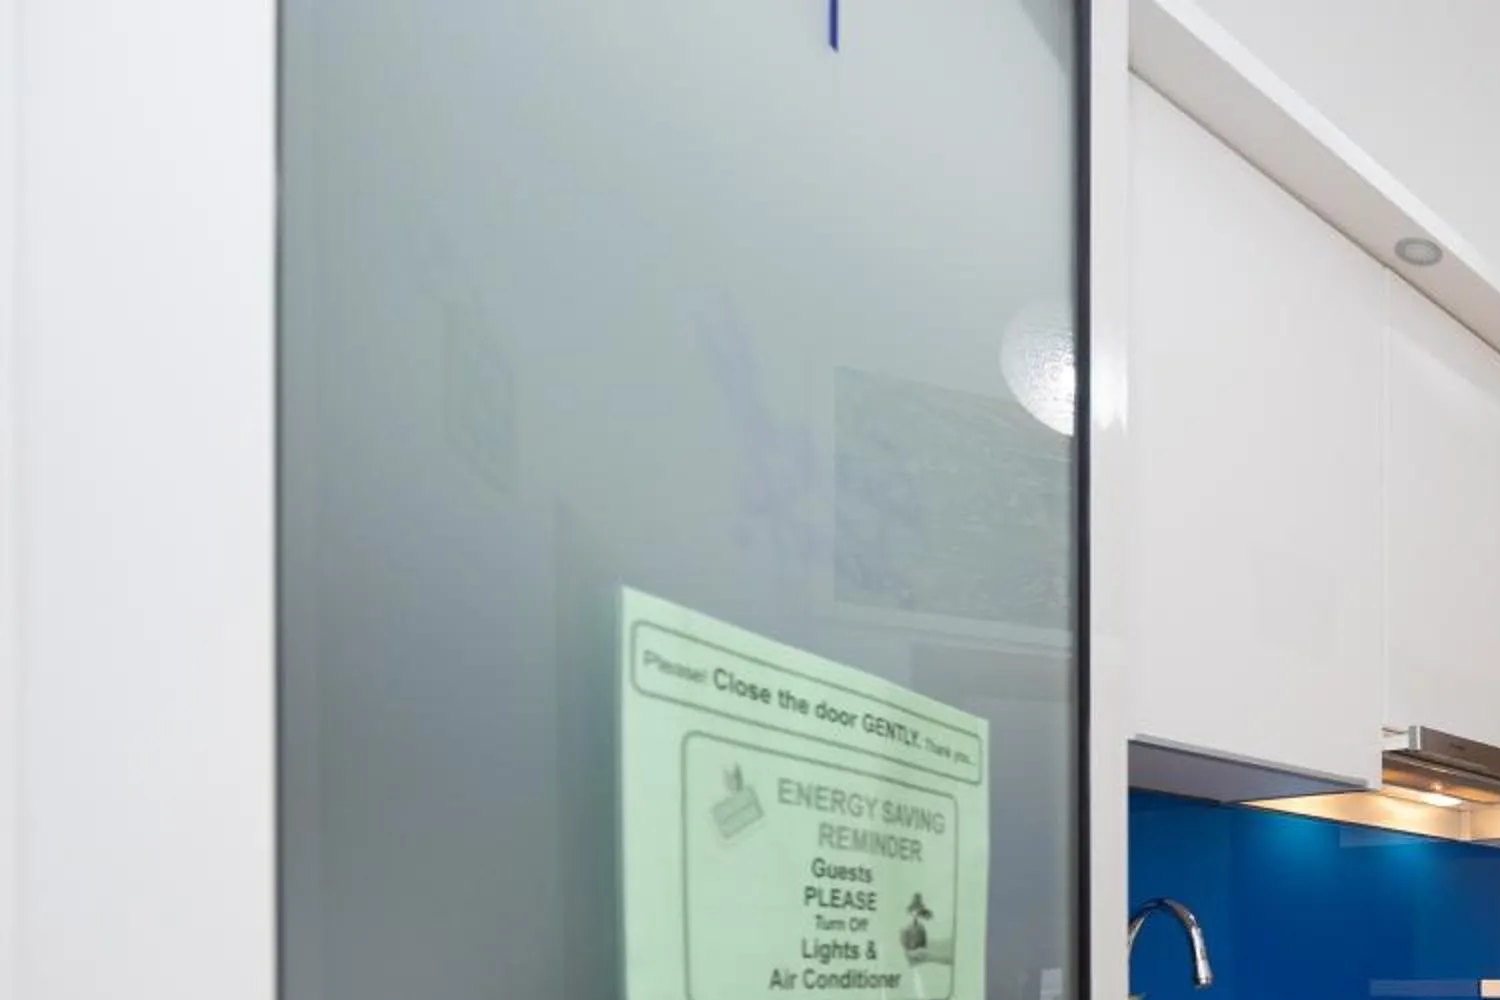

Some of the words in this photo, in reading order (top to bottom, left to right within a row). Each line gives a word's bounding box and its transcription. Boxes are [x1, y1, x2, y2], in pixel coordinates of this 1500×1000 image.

[713, 667, 772, 705] Close
[777, 688, 809, 716] the
[815, 701, 858, 729] door
[777, 776, 877, 820] ENERGY
[881, 799, 946, 836] SAVING
[818, 821, 923, 863] REMINDER
[811, 857, 873, 883] Guests
[804, 885, 877, 911] PLEASE
[815, 914, 846, 931] Turn
[849, 916, 870, 931] Off
[801, 937, 860, 965] Lights
[865, 939, 877, 960] &
[769, 968, 798, 990] Air
[802, 967, 902, 990] Conditioner
